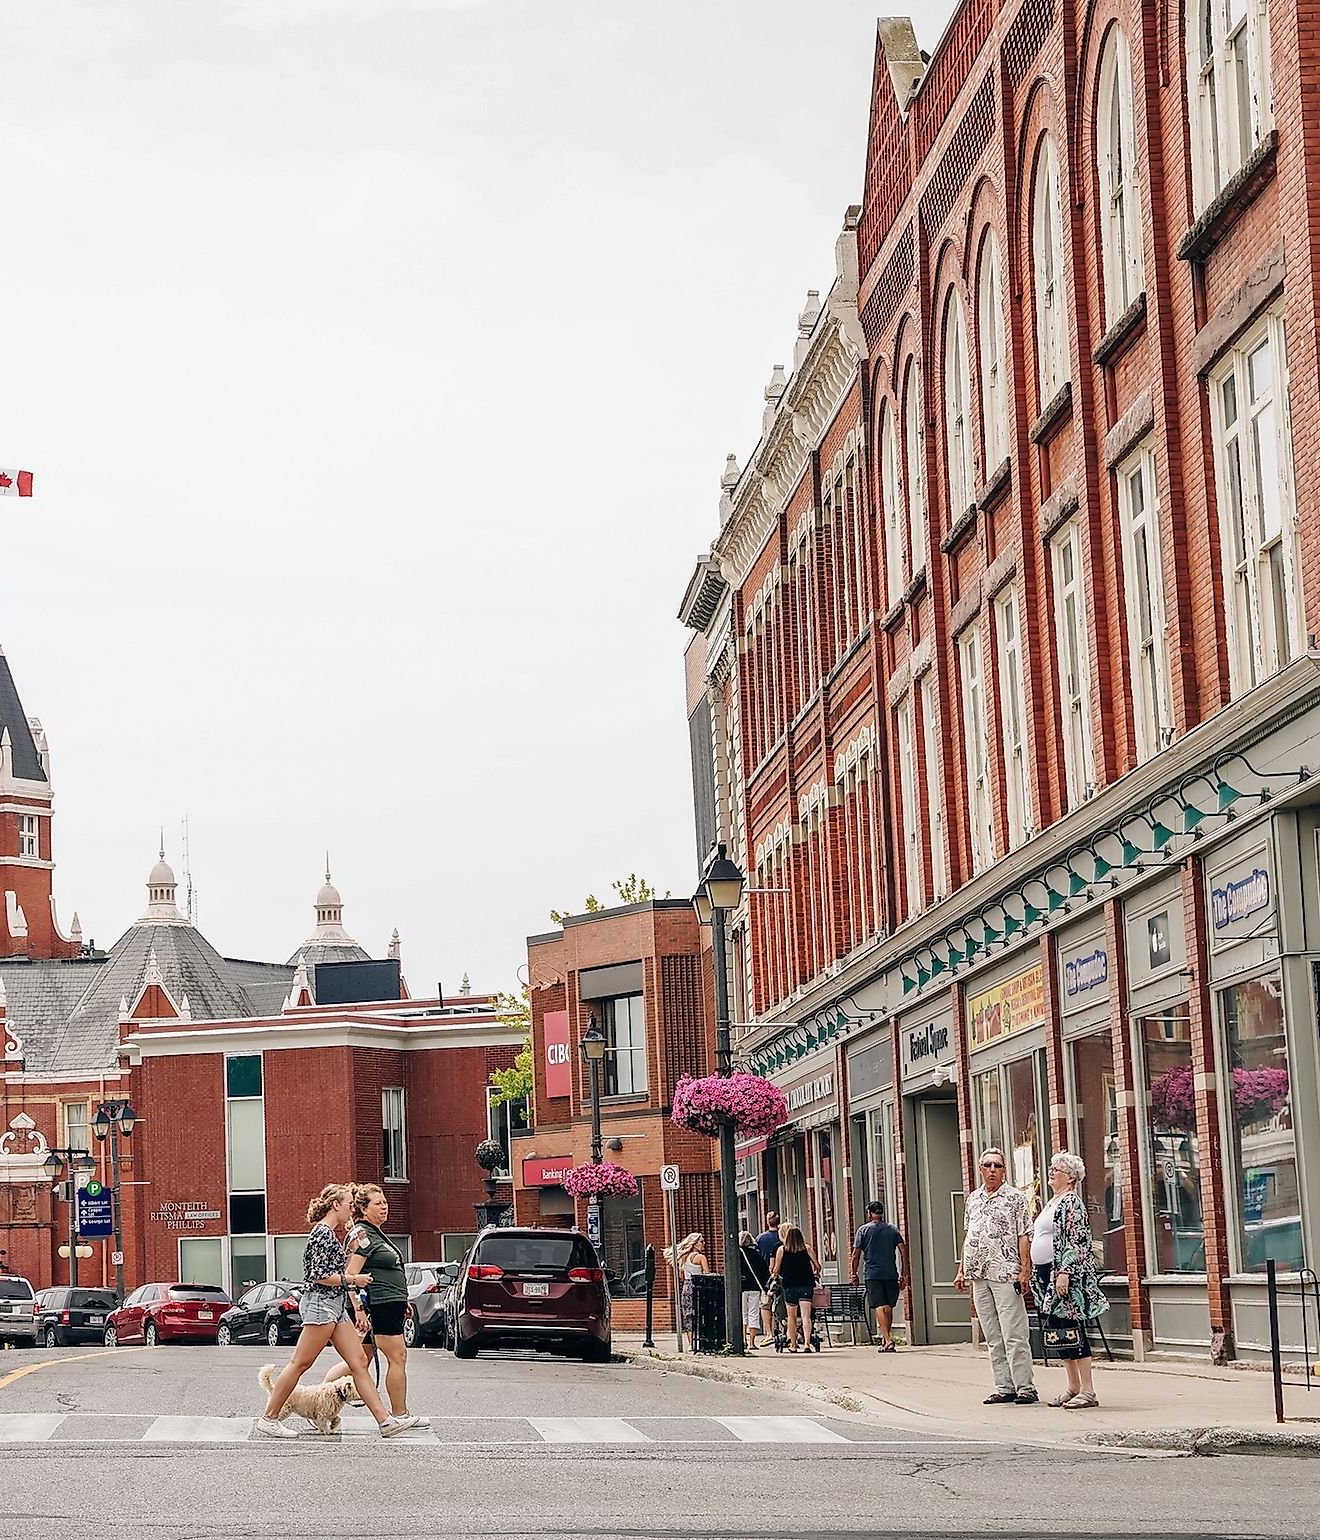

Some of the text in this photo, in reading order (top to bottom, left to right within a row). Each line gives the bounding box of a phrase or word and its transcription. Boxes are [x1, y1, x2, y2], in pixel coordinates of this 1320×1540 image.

[160, 1201, 208, 1212] MONTEITH
[150, 1211, 184, 1221] RITSMA
[167, 1220, 205, 1230] PHILLIPS
